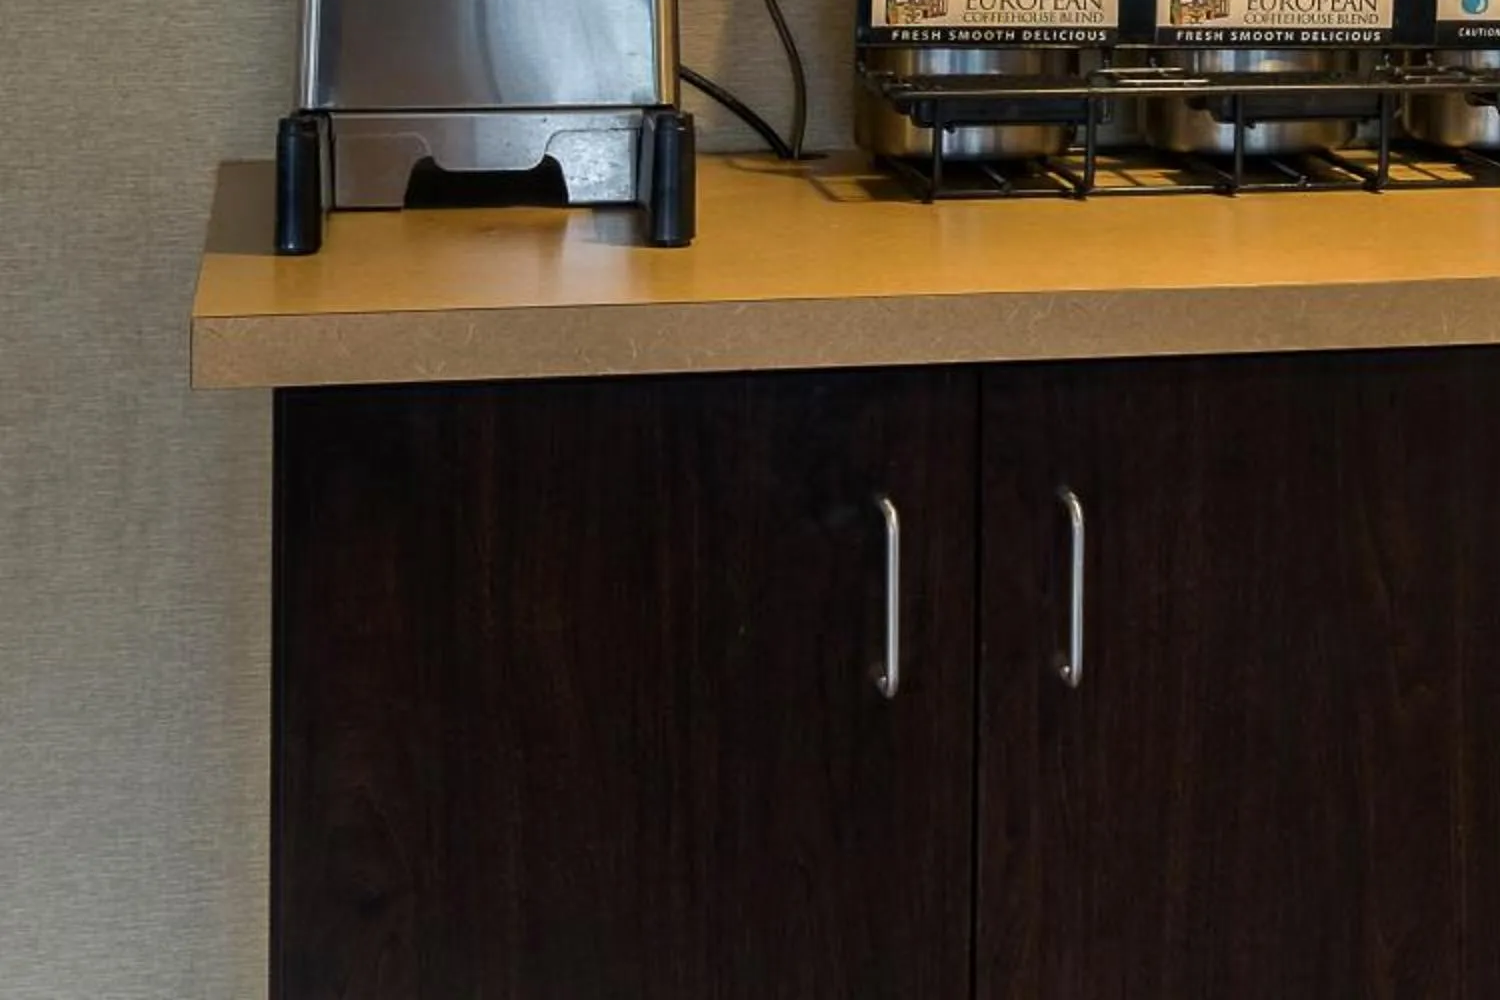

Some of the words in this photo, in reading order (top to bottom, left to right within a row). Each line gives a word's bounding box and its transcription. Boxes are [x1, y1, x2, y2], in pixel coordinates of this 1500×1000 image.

[963, 11, 1057, 24] COFFEEHOUSE
[1058, 11, 1105, 24] BLEND
[1243, 12, 1334, 25] COFFEEHOUSE
[1337, 13, 1380, 25] BLEND
[892, 30, 941, 41] FRESH
[949, 30, 1015, 41] SMOOTH
[1022, 30, 1107, 41] DELICIOUS
[1177, 31, 1224, 42] FRESH
[1230, 31, 1295, 42] SMOOTH
[1300, 31, 1382, 42] DELICIOUS
[1458, 27, 1500, 37] CAUTION
